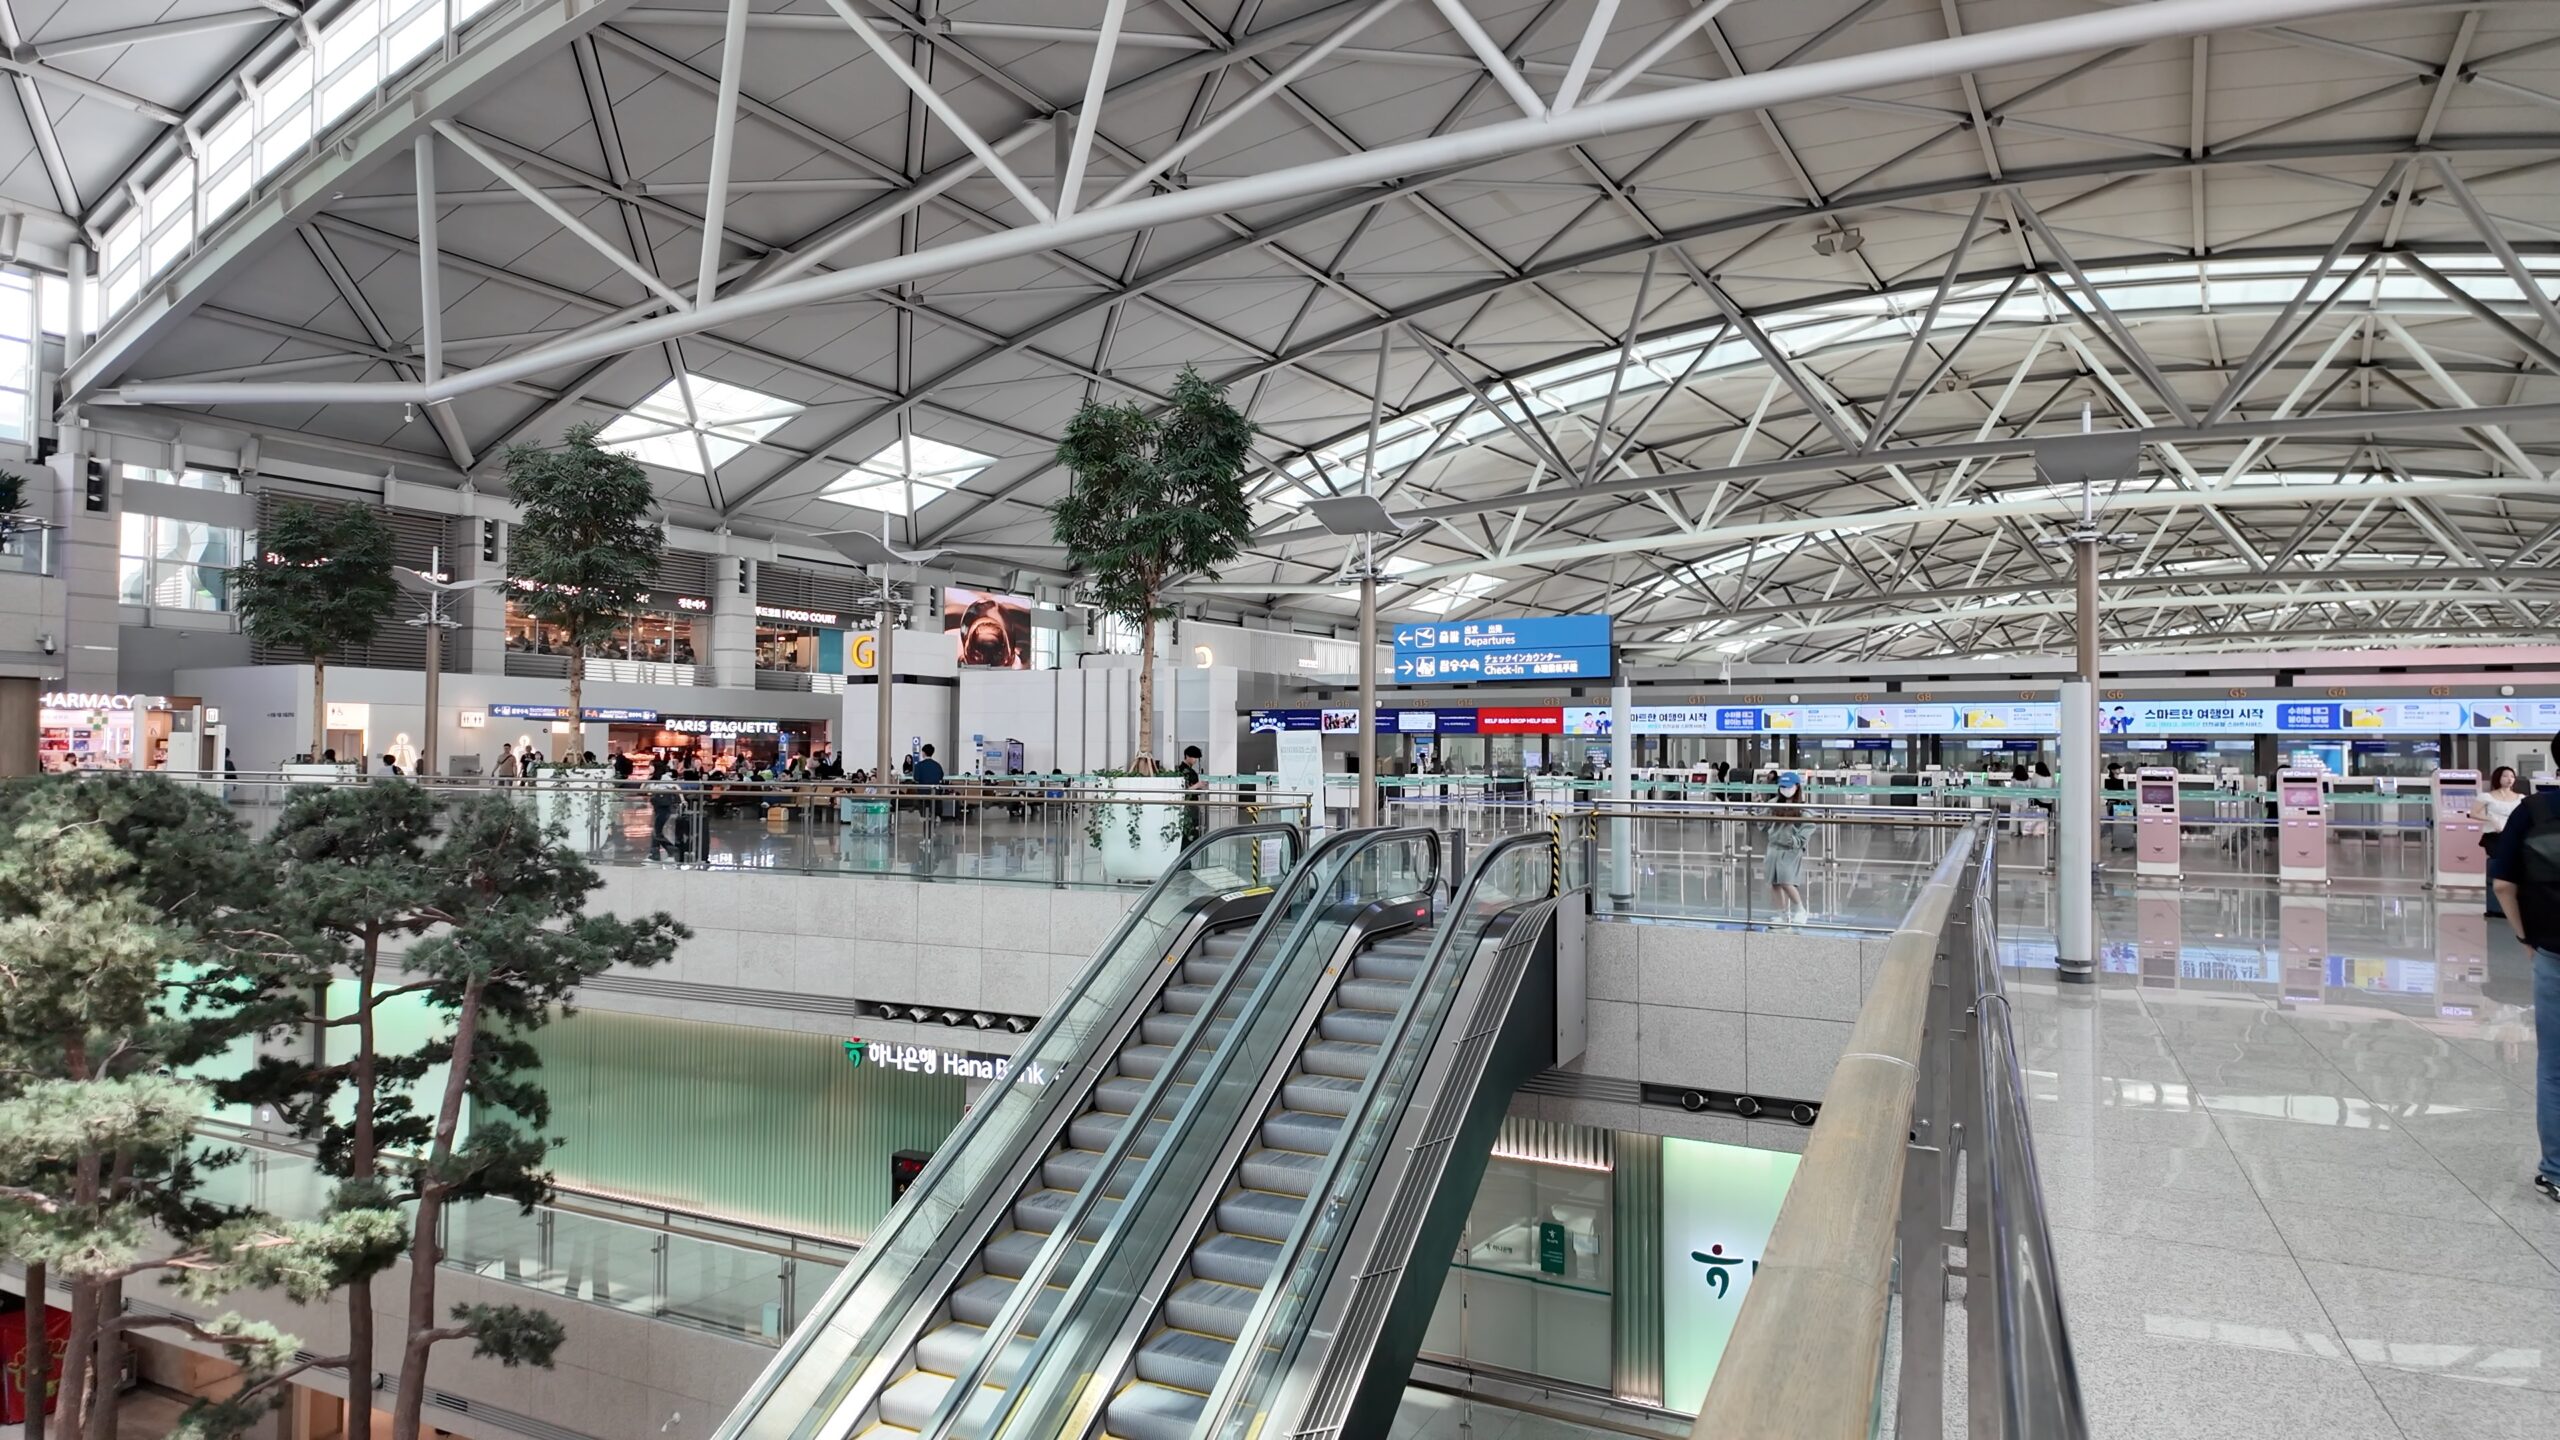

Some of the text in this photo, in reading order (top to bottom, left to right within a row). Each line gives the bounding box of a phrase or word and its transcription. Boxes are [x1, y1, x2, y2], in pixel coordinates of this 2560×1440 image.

[786, 610, 809, 621] FOOD
[809, 612, 837, 624] COURT
[1464, 636, 1516, 648] Departures
[852, 635, 875, 669] G
[1484, 652, 1562, 664] チェックインカウンター
[1439, 658, 1480, 673] 탑승수속
[1484, 664, 1524, 675] Check-in
[2020, 691, 2036, 700] G7
[2107, 690, 2124, 699] G6
[2229, 688, 2247, 698] G5
[2328, 687, 2346, 697] G4
[2430, 686, 2450, 696] G3
[1543, 697, 1561, 706] G13
[1593, 696, 1610, 705] G12
[1688, 695, 1706, 704] G11
[1744, 694, 1764, 704] G10
[1855, 693, 1869, 702] G9
[1916, 692, 1932, 701] G8
[1413, 699, 1429, 707] G15
[2144, 708, 2264, 720] 스마트한 여행의 시작
[2288, 706, 2311, 715] 수하물
[1658, 713, 1686, 723] 여행의
[1688, 712, 1707, 722] 시작
[665, 719, 778, 734] PARIS BAGUETTE
[868, 1043, 1045, 1086] 하나은행 Hana Bnk
